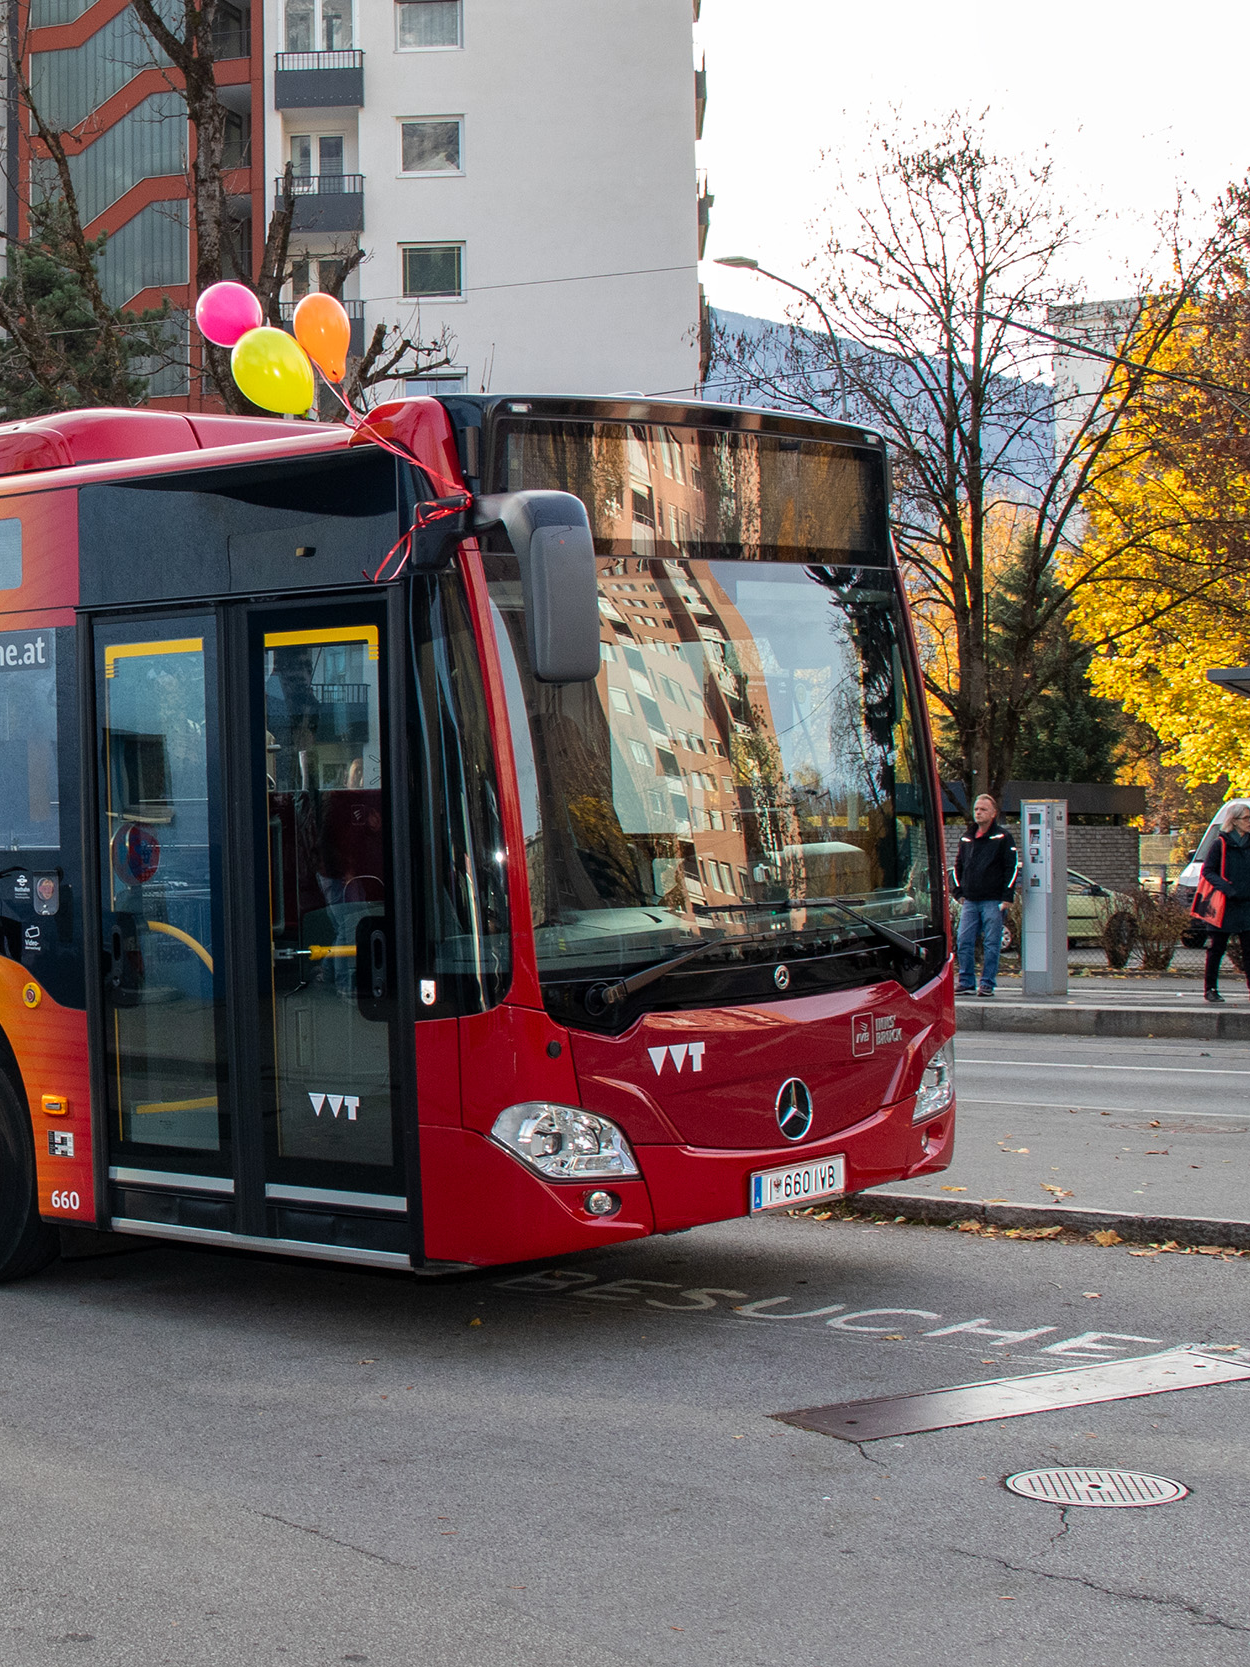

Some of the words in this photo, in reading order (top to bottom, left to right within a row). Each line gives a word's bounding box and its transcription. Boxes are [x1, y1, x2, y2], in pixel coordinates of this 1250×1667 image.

[783, 1170, 810, 1197] 660
[813, 1165, 835, 1191] IVB
[51, 1190, 80, 1210] 660
